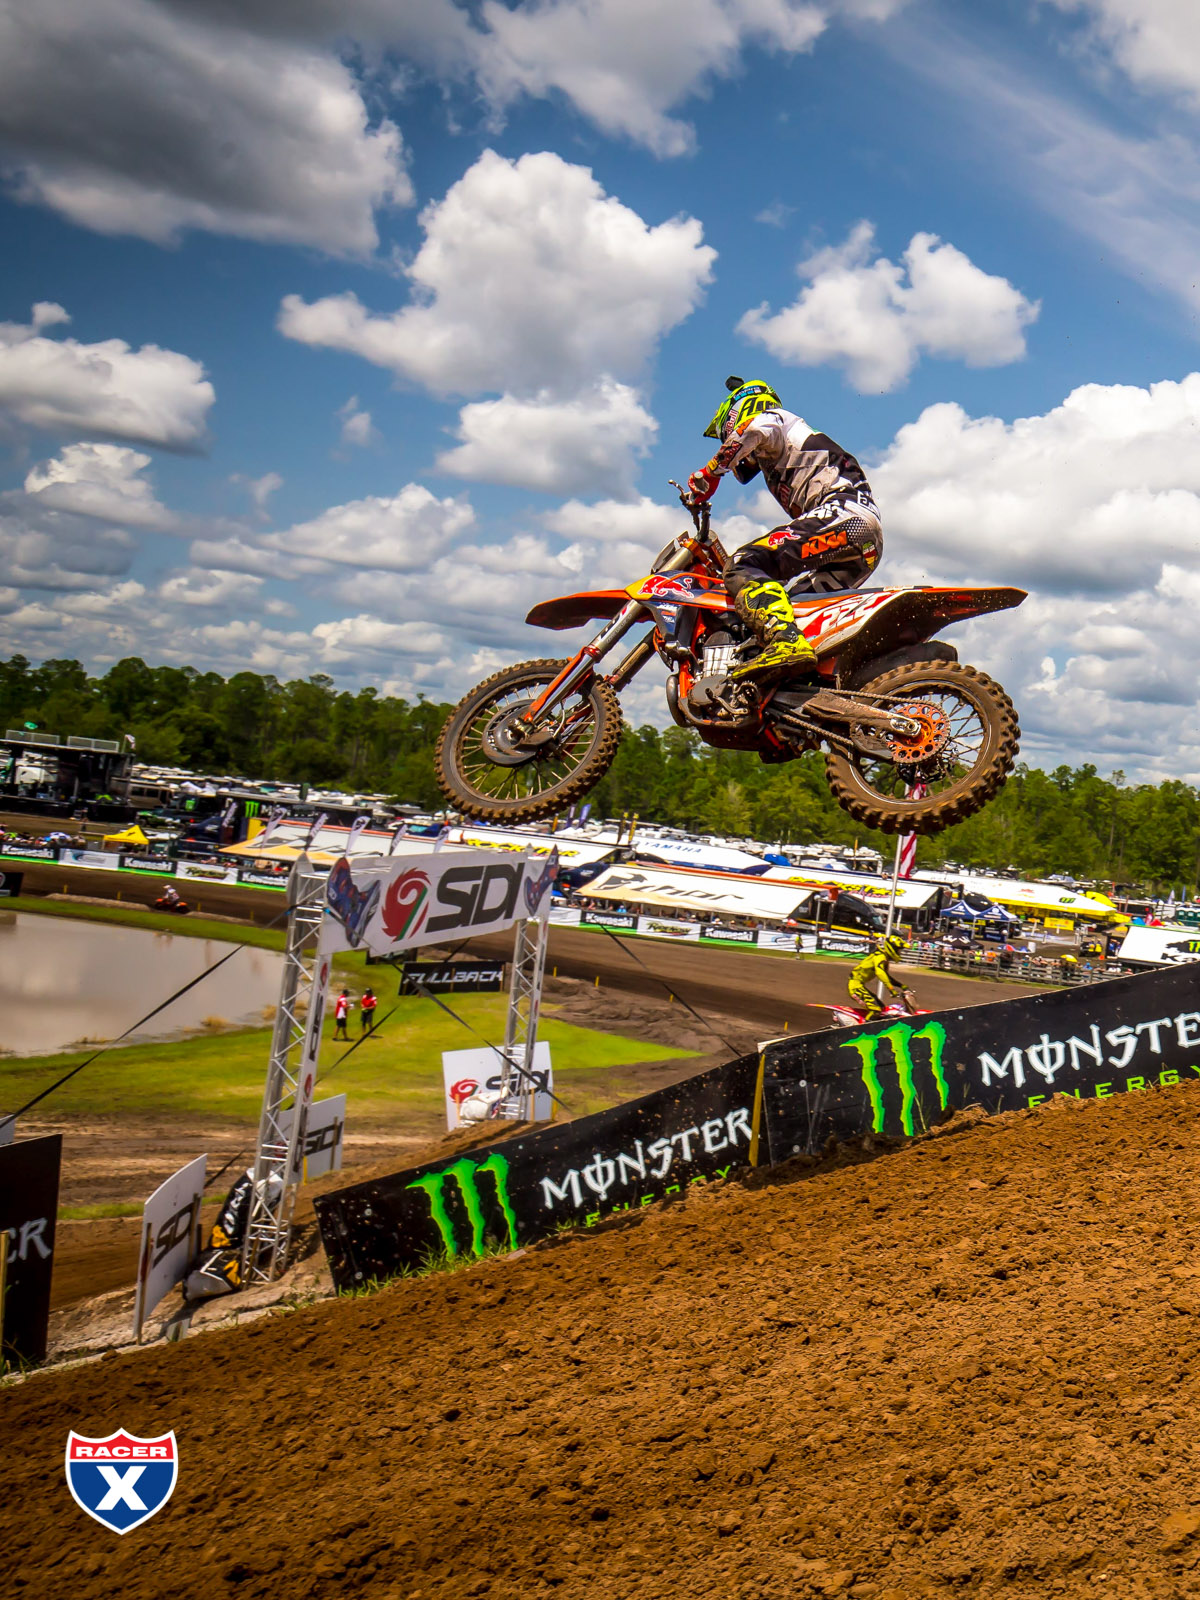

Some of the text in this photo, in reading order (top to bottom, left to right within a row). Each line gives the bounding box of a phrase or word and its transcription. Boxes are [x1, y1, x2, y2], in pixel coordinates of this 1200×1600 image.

[801, 531, 847, 559] KTM
[645, 842, 702, 853] YAMAHA
[124, 857, 172, 871] Kawasaki
[585, 912, 633, 927] Kawasaki
[705, 927, 753, 942] Kawasaki
[821, 939, 870, 953] Kawasaki
[539, 1107, 753, 1209] MONSTER
